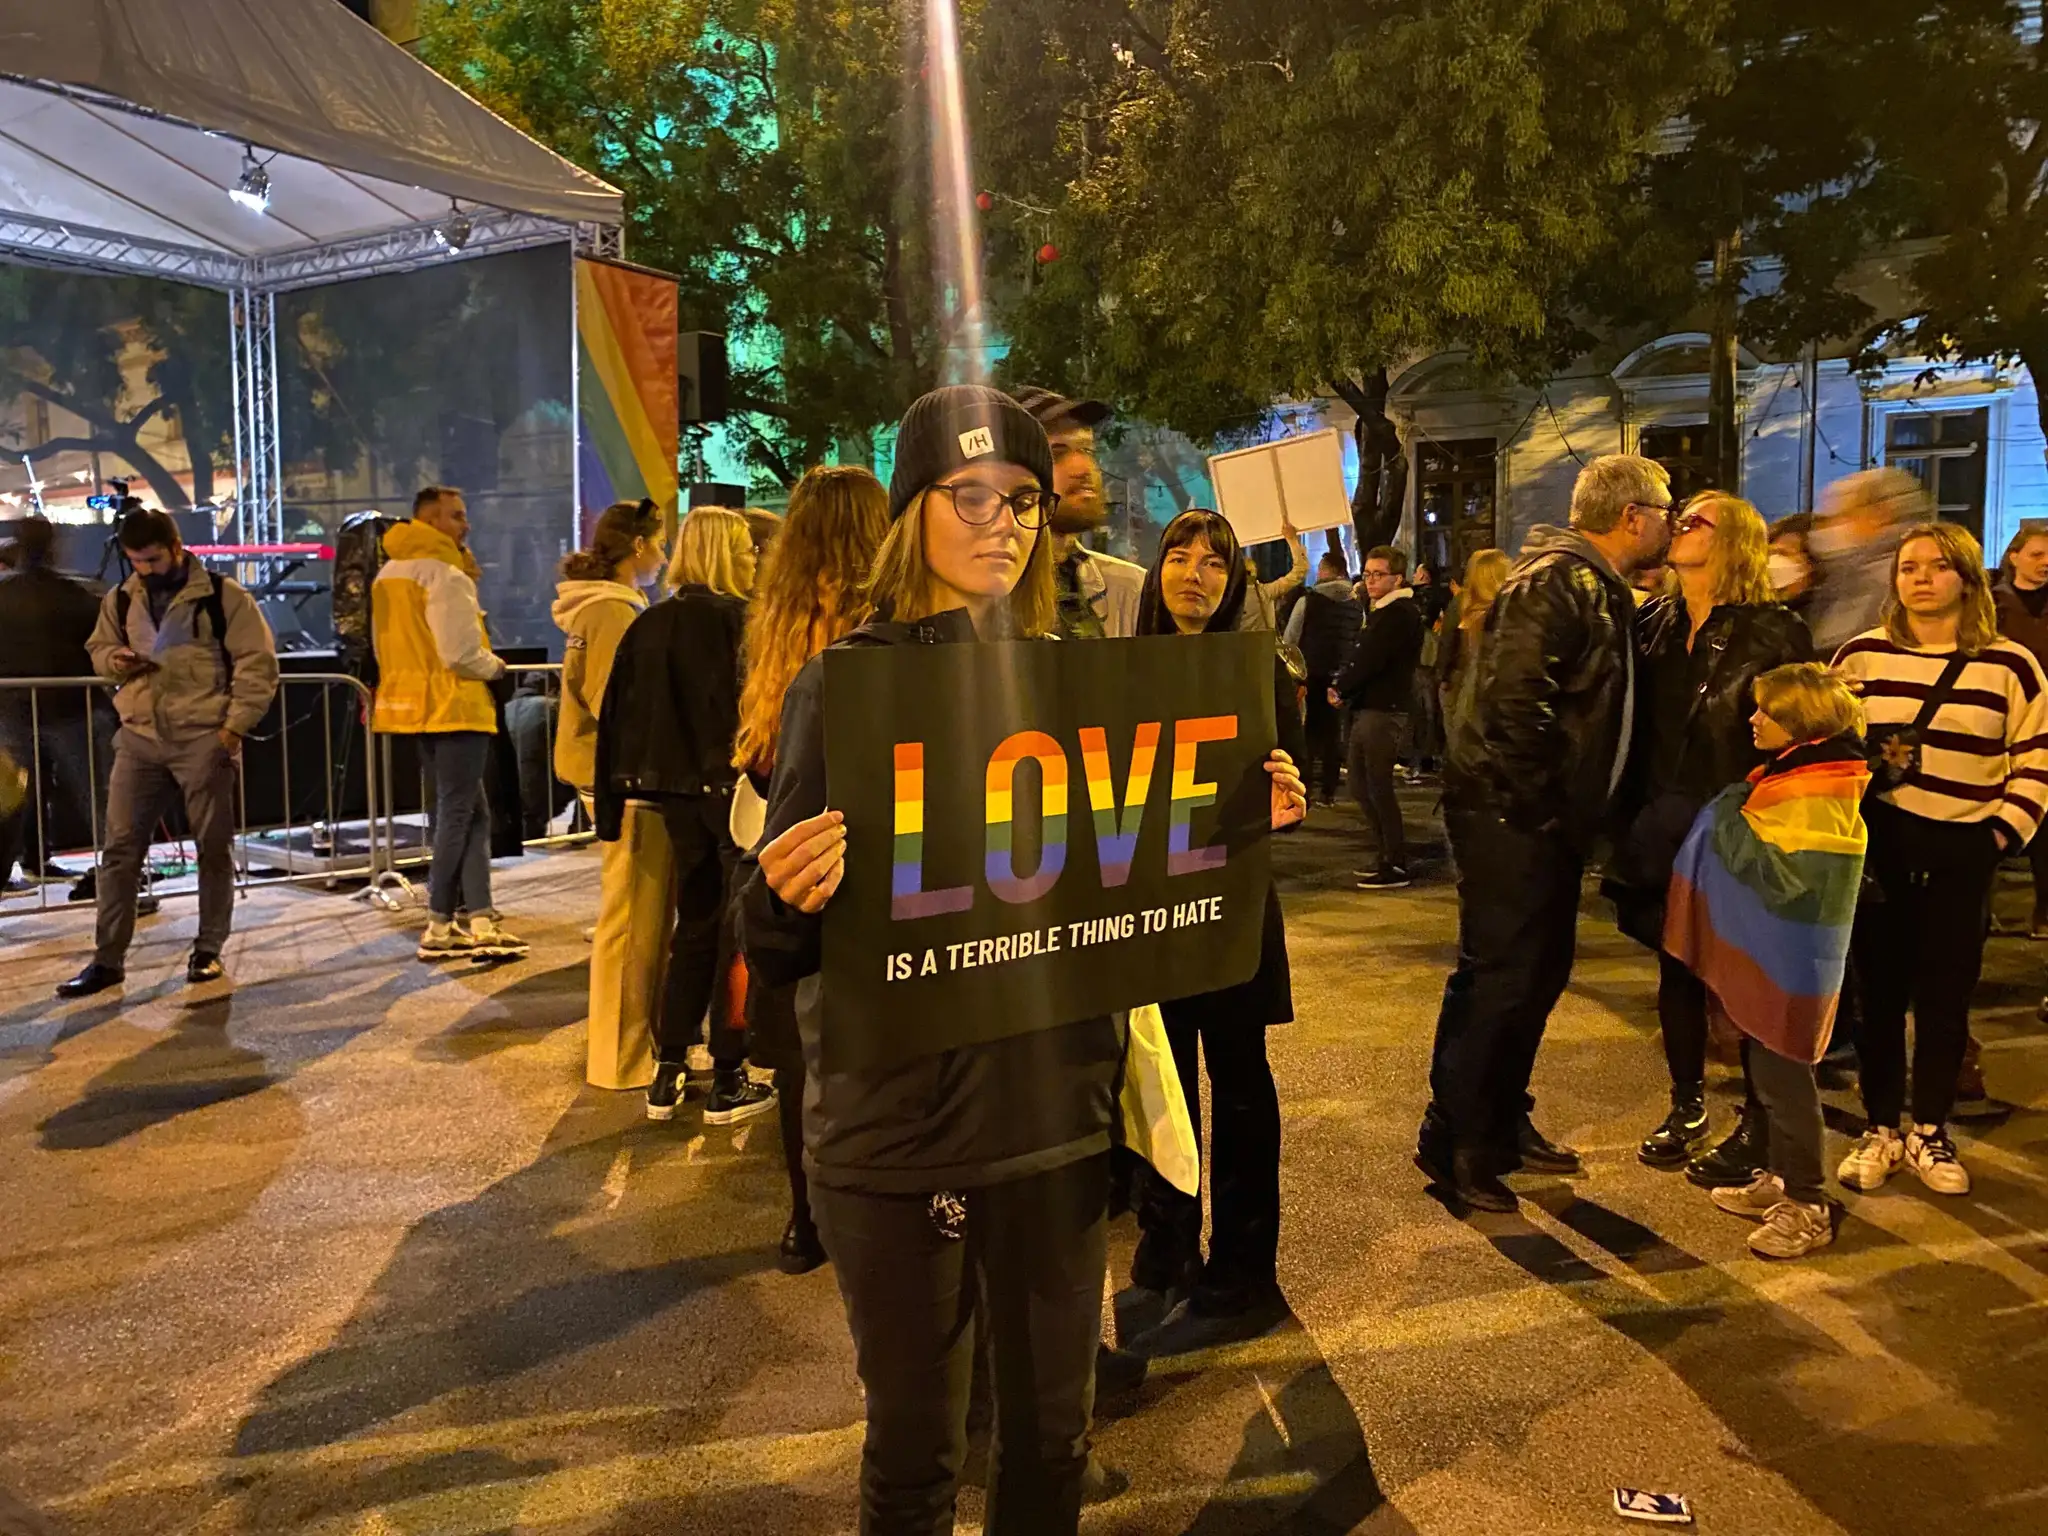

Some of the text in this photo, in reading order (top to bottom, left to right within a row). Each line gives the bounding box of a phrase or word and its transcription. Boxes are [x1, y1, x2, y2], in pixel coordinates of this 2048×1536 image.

[890, 714, 1239, 921] LOVE
[886, 895, 1224, 982] IS A TERRIBLE THING TO HATE
